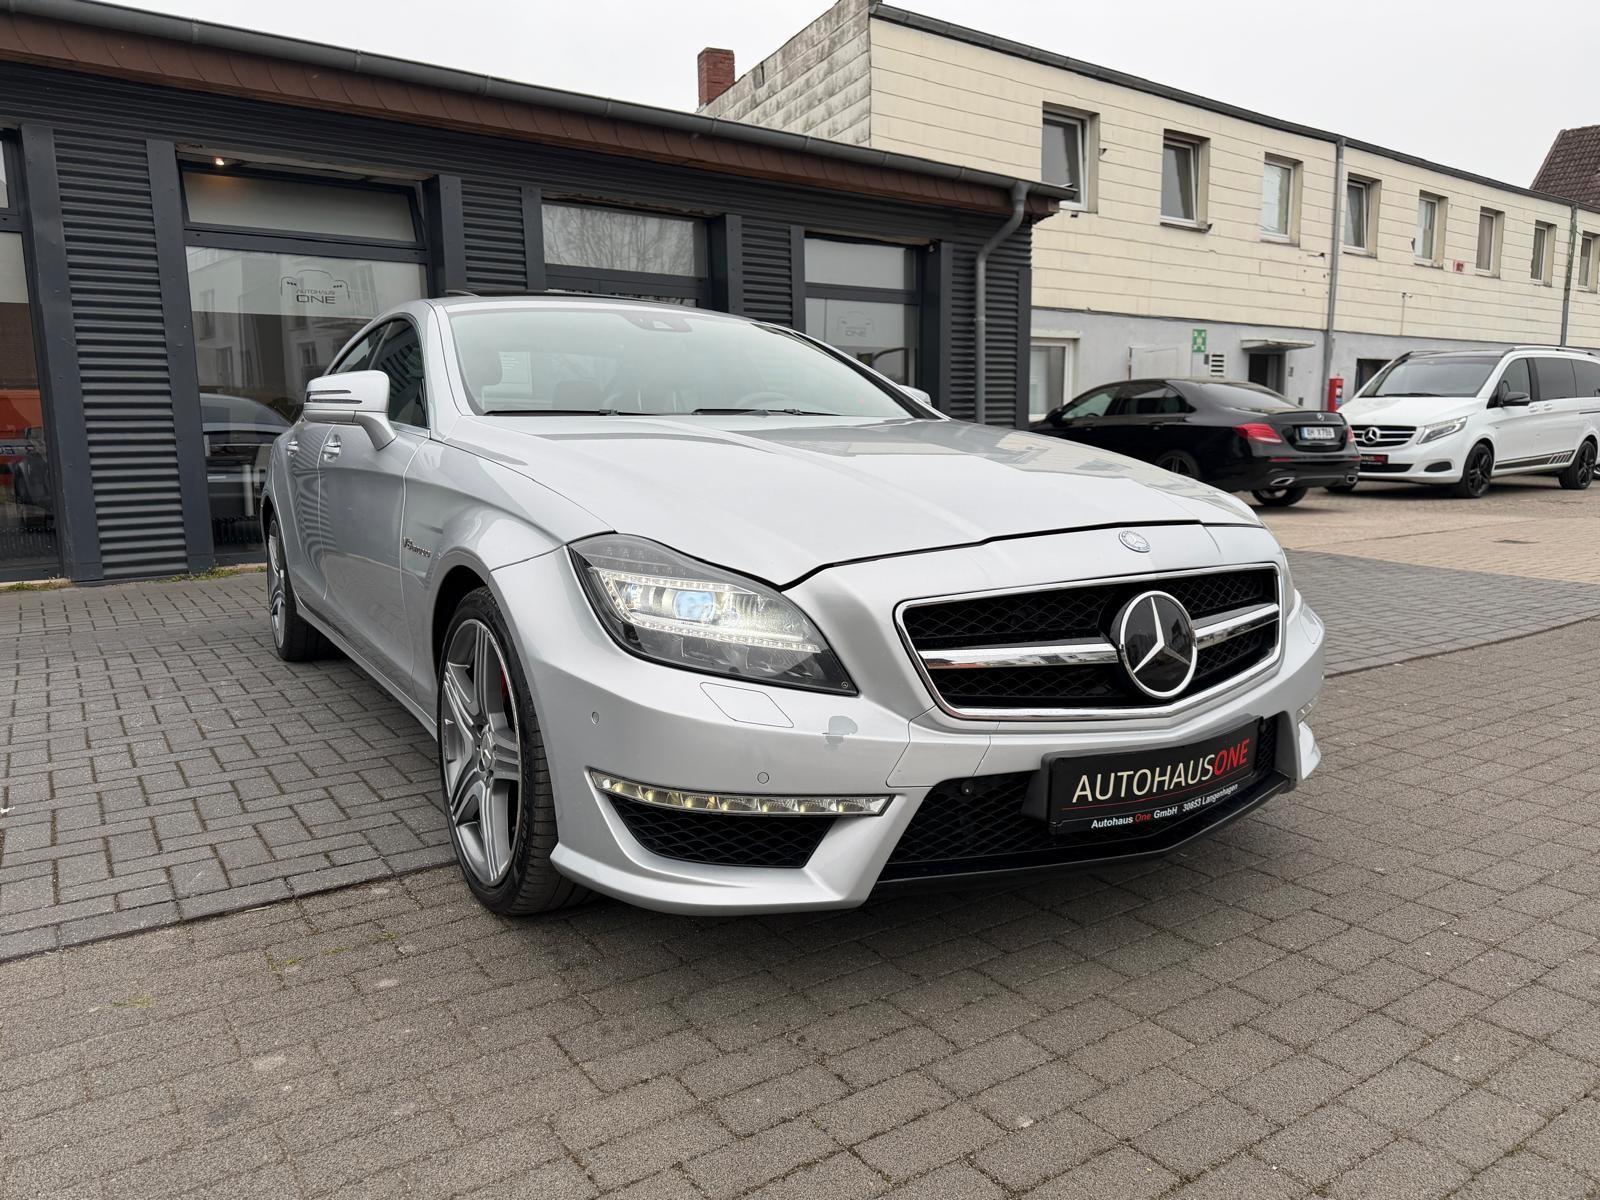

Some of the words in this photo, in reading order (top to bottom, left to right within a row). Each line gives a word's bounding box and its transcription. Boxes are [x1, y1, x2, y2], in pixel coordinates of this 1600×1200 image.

[296, 294, 336, 305] ONE
[1091, 815, 1134, 829] Autohaus
[1135, 813, 1152, 822] One
[1153, 806, 1178, 819] GmbH
[1201, 783, 1239, 806] Langenhagen
